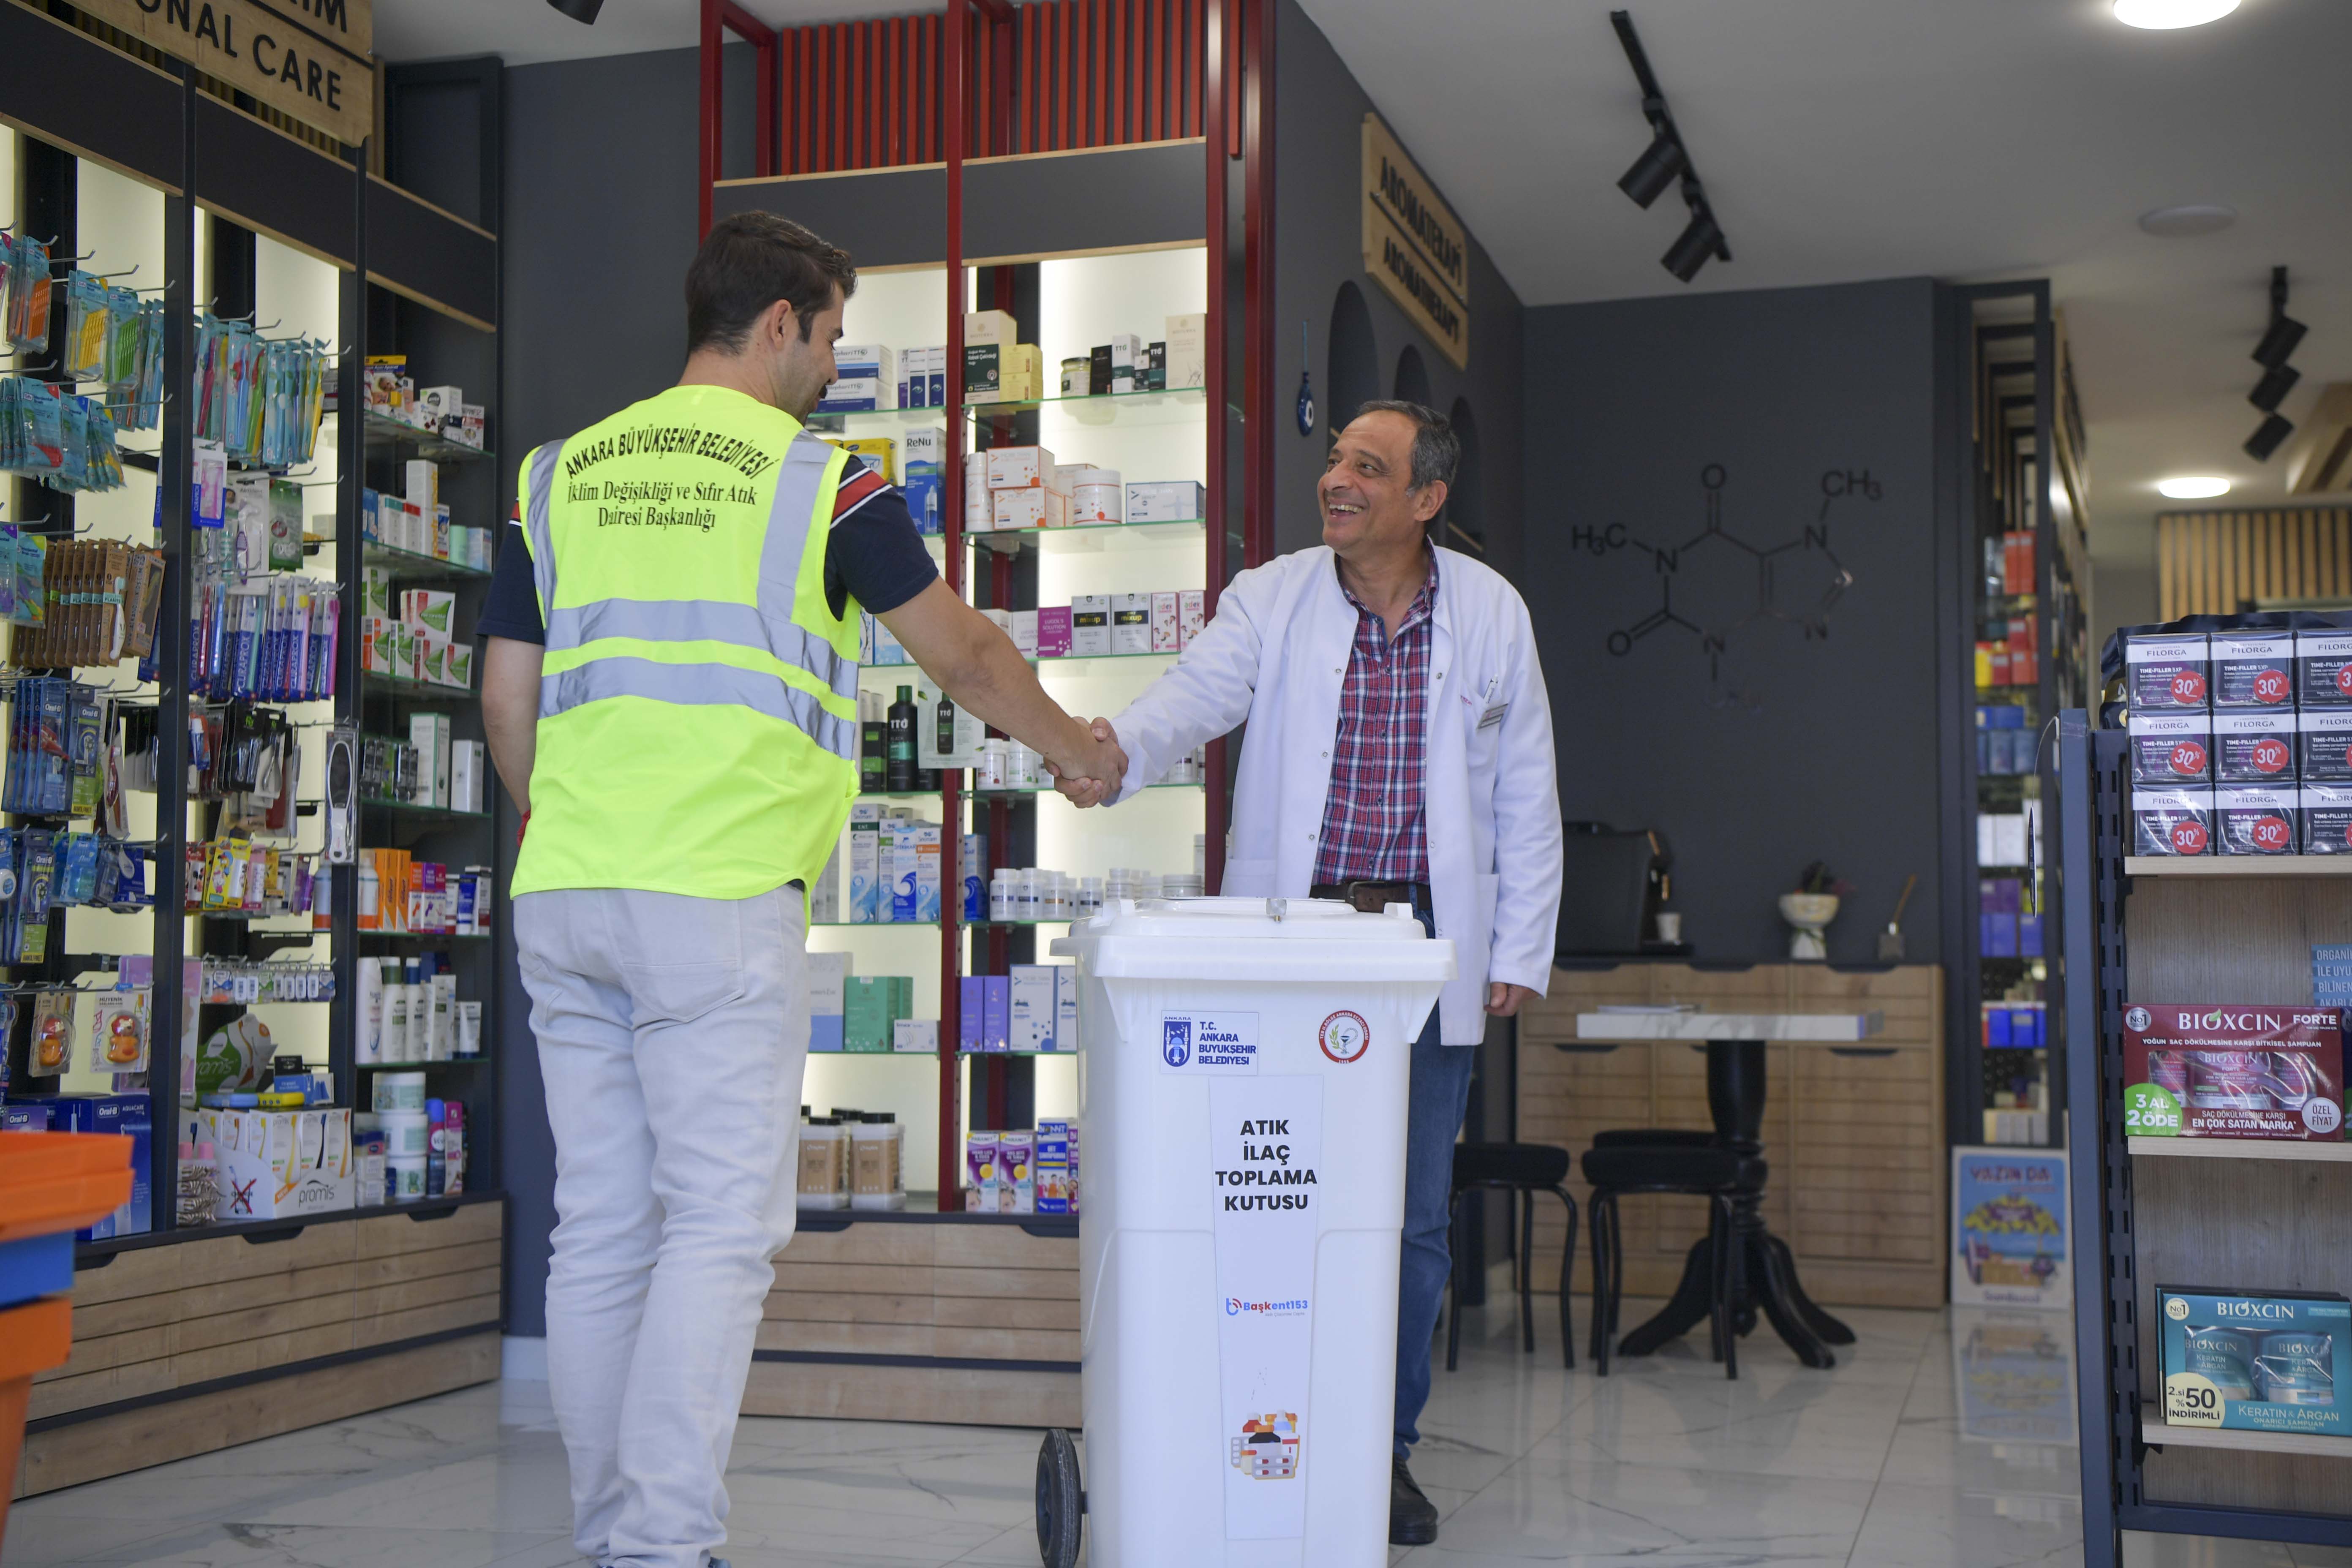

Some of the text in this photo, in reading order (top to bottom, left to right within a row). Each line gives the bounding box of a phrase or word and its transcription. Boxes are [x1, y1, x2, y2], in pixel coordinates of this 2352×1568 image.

[253, 34, 340, 111] CARE
[907, 438, 931, 447] ReNu
[566, 423, 780, 479] ANKARA BÜYÜKŞEHİR BELEDİYESİ
[567, 481, 758, 505] İklim Değişikliği ve Sıfır Atık
[598, 506, 716, 532] Dairesi Başkanlığı
[1805, 525, 1827, 549] N
[1657, 550, 1677, 574] N
[237, 635, 250, 689] CURAPROX
[45, 704, 61, 712] Oral-B
[82, 709, 98, 717] Oral-B
[2318, 964, 2331, 977] İLE
[1199, 1021, 1217, 1030] T.C.
[2178, 1008, 2337, 1031] BIOXCIN FORTE
[1199, 1033, 1239, 1042] ANKARA
[2205, 1054, 2257, 1064] BIOXCIN
[2136, 1094, 2169, 1109] 3 AL
[2312, 1103, 2331, 1114] ÖZEL
[98, 1107, 118, 1115] Oral-B
[2202, 1110, 2286, 1120] SAÇ DÖKÜLMESİNE KARŞI
[9, 1115, 28, 1123] Oral-B
[2127, 1111, 2178, 1127] 2 ÖDE
[2192, 1118, 2204, 1127] EN
[2207, 1119, 2226, 1130] ÇOK
[2228, 1120, 2257, 1129] SATAN
[2312, 1115, 2333, 1126] FİYAT
[1240, 1120, 1290, 1135] ATIK
[1243, 1141, 1290, 1166] İLAÇ
[1215, 1169, 1318, 1186] TOPLAMA
[299, 1187, 334, 1208] promis
[1225, 1194, 1308, 1211] KUTUSU
[1244, 1300, 1308, 1313] Başkent153
[2217, 1301, 2294, 1318] BIOXCIN
[2185, 1339, 2237, 1352] BIOXCIN
[2169, 1407, 2220, 1420] İNDİRİMLİ
[2239, 1404, 2286, 1418] KERATIN
[2298, 1408, 2339, 1422] ARGAN
